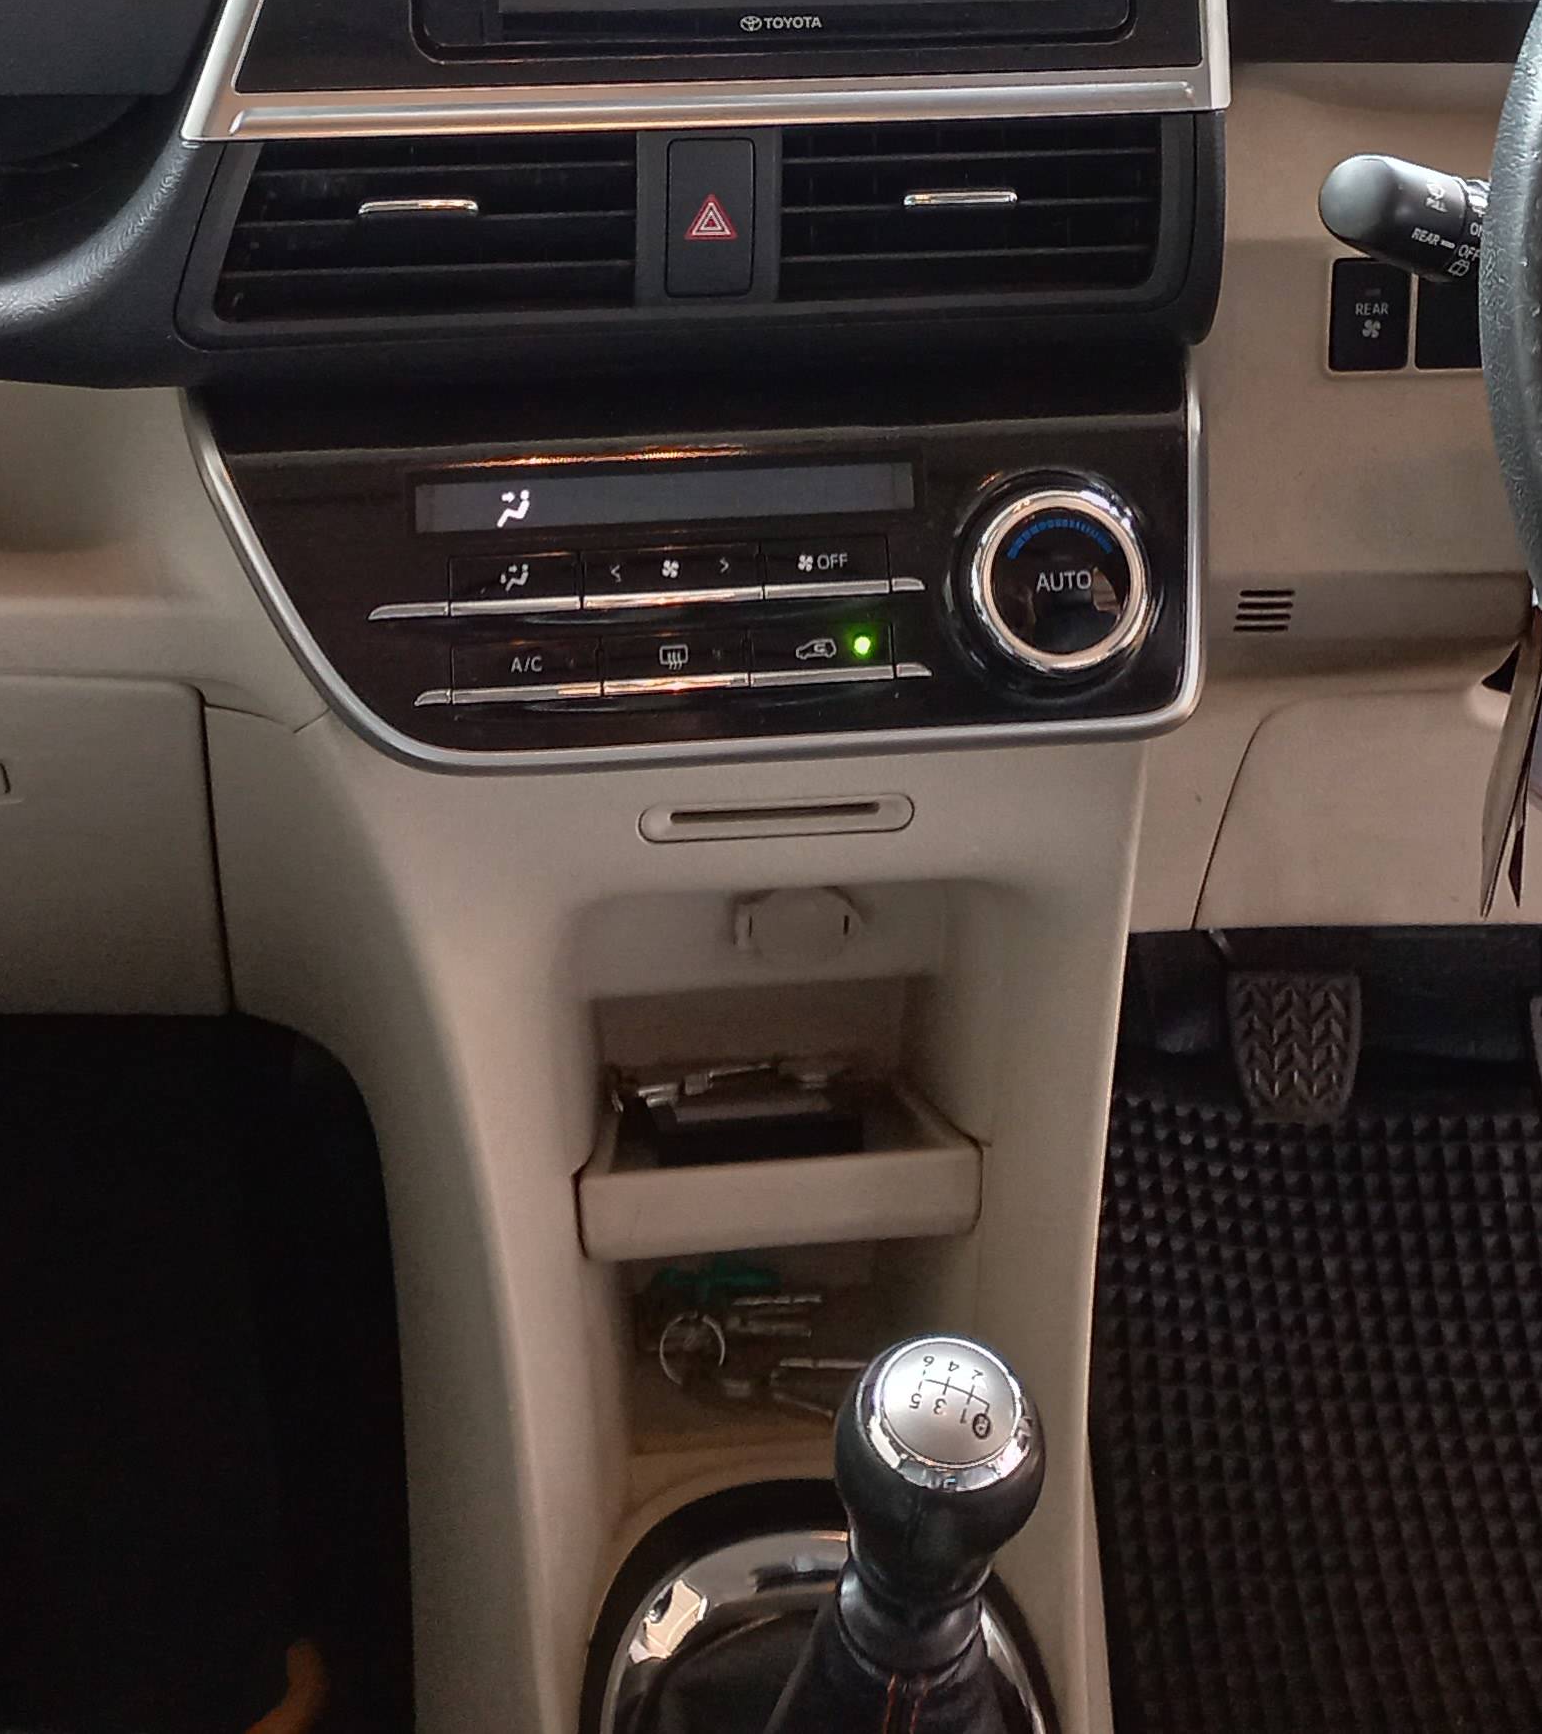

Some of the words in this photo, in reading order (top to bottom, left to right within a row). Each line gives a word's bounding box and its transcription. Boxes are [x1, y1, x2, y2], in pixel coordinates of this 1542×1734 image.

[763, 16, 823, 30] TOYOTA
[1411, 227, 1441, 247] REAR
[1458, 244, 1481, 262] OFF
[1355, 302, 1390, 316] REAR
[817, 552, 849, 571] OFF
[1035, 570, 1092, 593] AUTO
[510, 655, 544, 674] A/C
[922, 1354, 935, 1367] 6
[947, 1360, 960, 1373] 4
[908, 1392, 923, 1410] 5
[932, 1397, 948, 1415] 3
